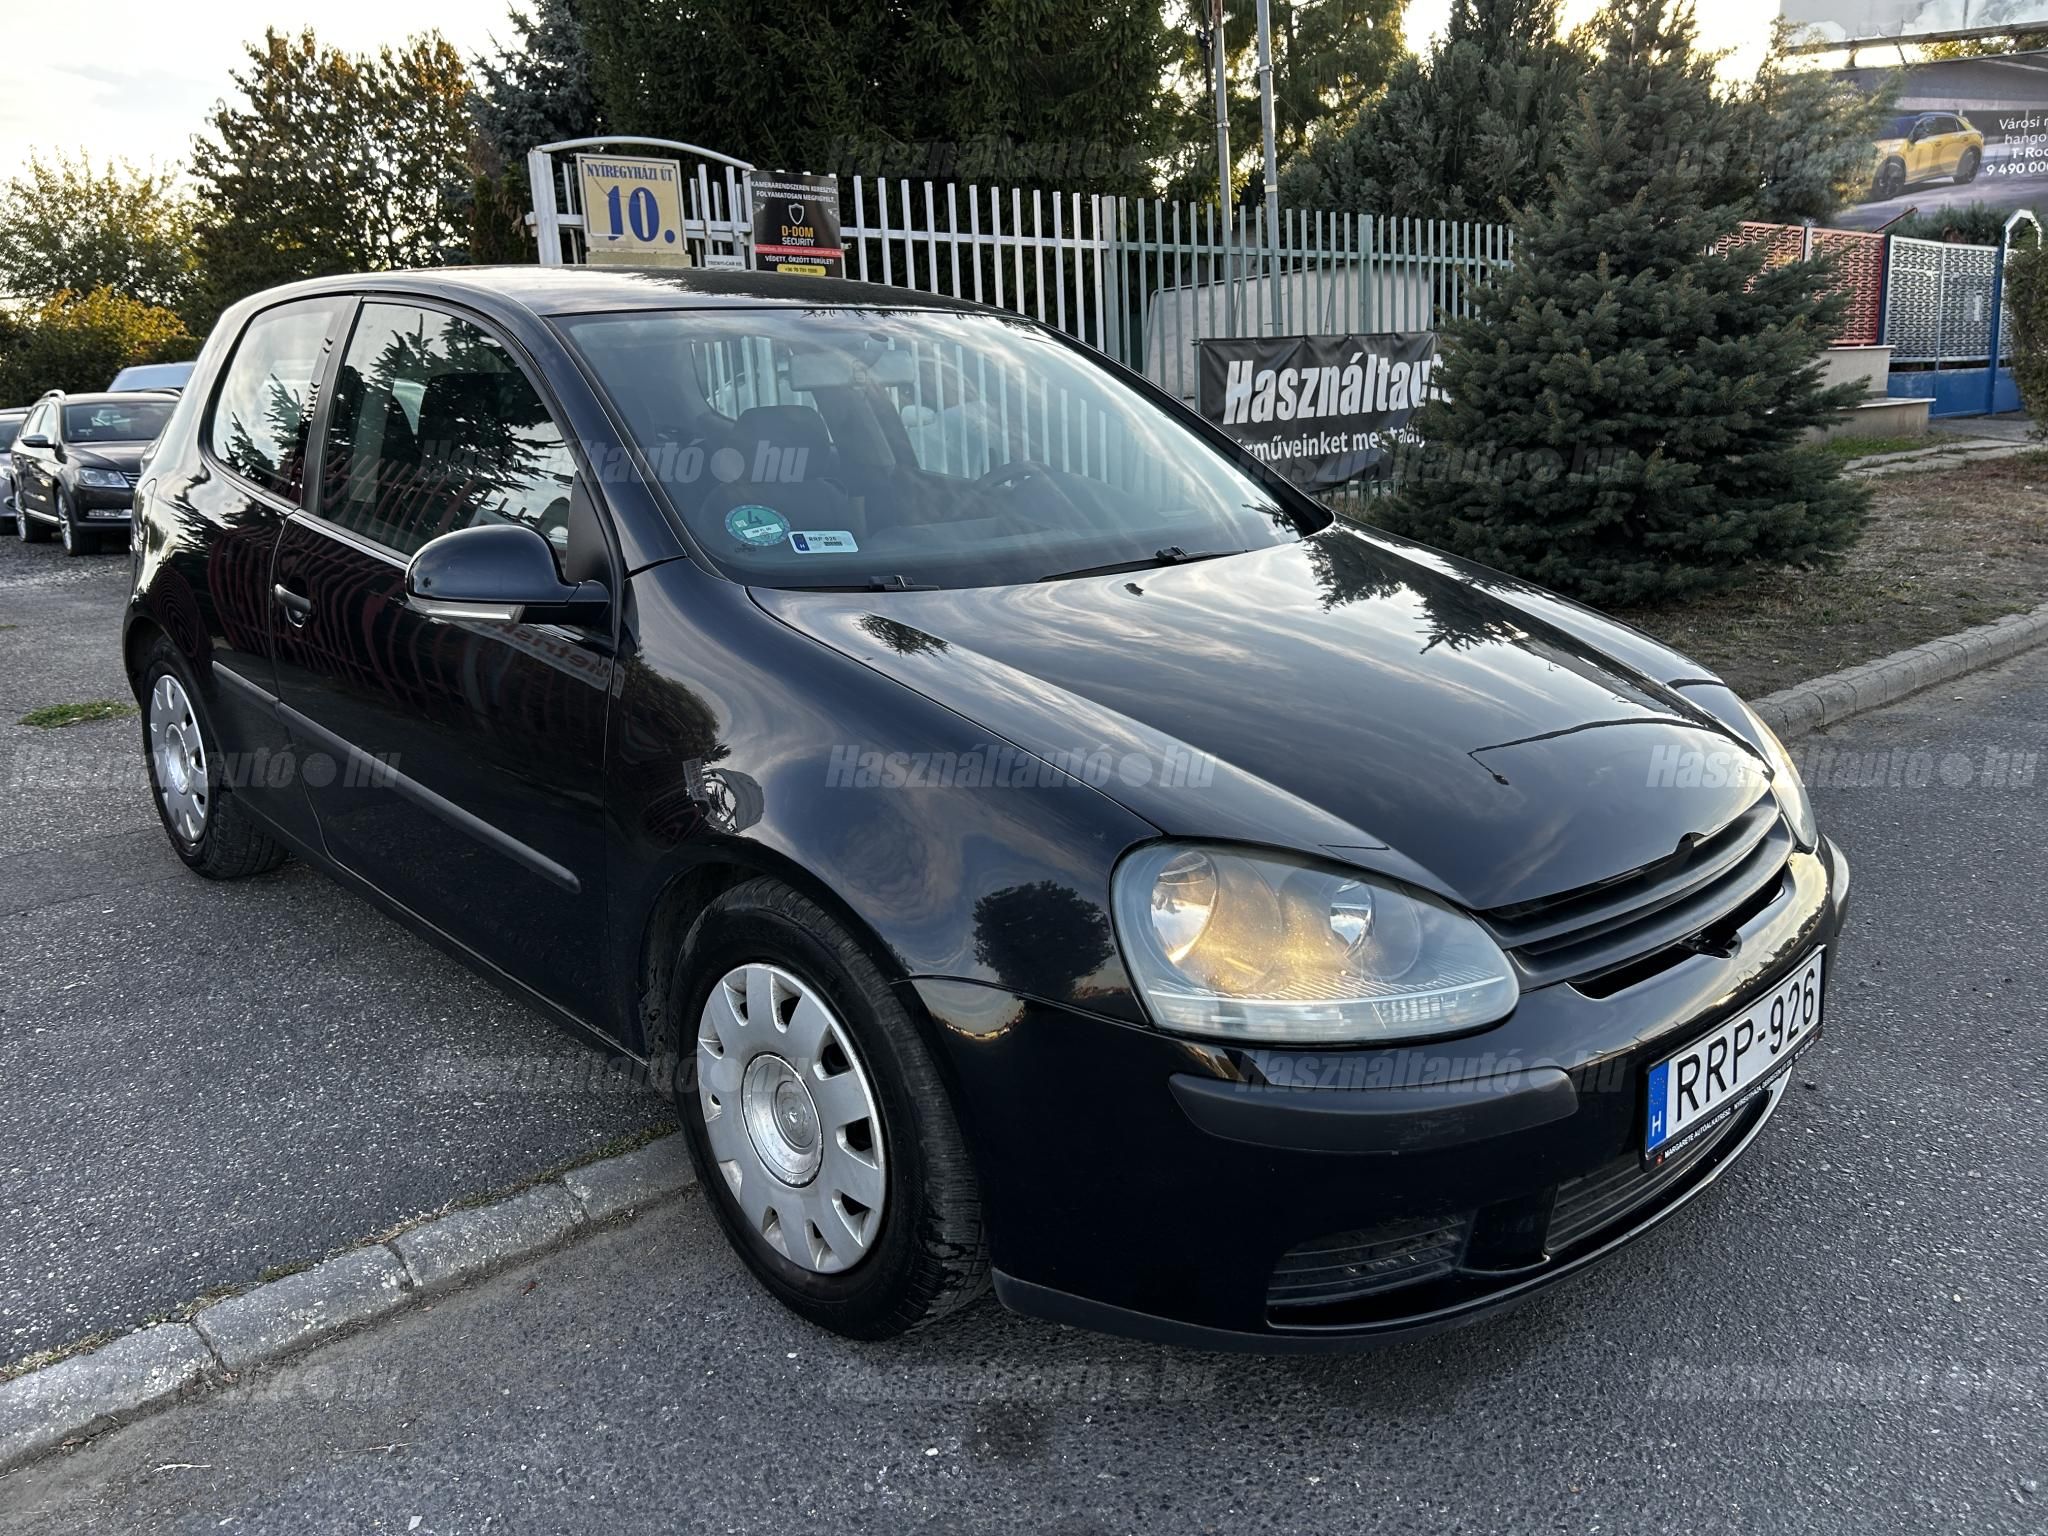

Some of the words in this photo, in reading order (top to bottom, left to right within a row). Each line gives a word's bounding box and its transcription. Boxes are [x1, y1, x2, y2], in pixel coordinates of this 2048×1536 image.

[1999, 116, 2040, 130] Városi
[586, 163, 658, 181] NYÍREGYHÁZI
[660, 167, 673, 182] ÚT
[1986, 163, 1996, 176] 9
[1998, 162, 2025, 175] 490
[2028, 160, 2048, 174] 00
[756, 190, 803, 200] FOLYAMATOSAN
[607, 185, 676, 244] 10.
[781, 225, 814, 238] D-DOM
[781, 237, 815, 247] SECURITY
[1675, 967, 1816, 1123] RRP-926
[1651, 1110, 1662, 1137] H
